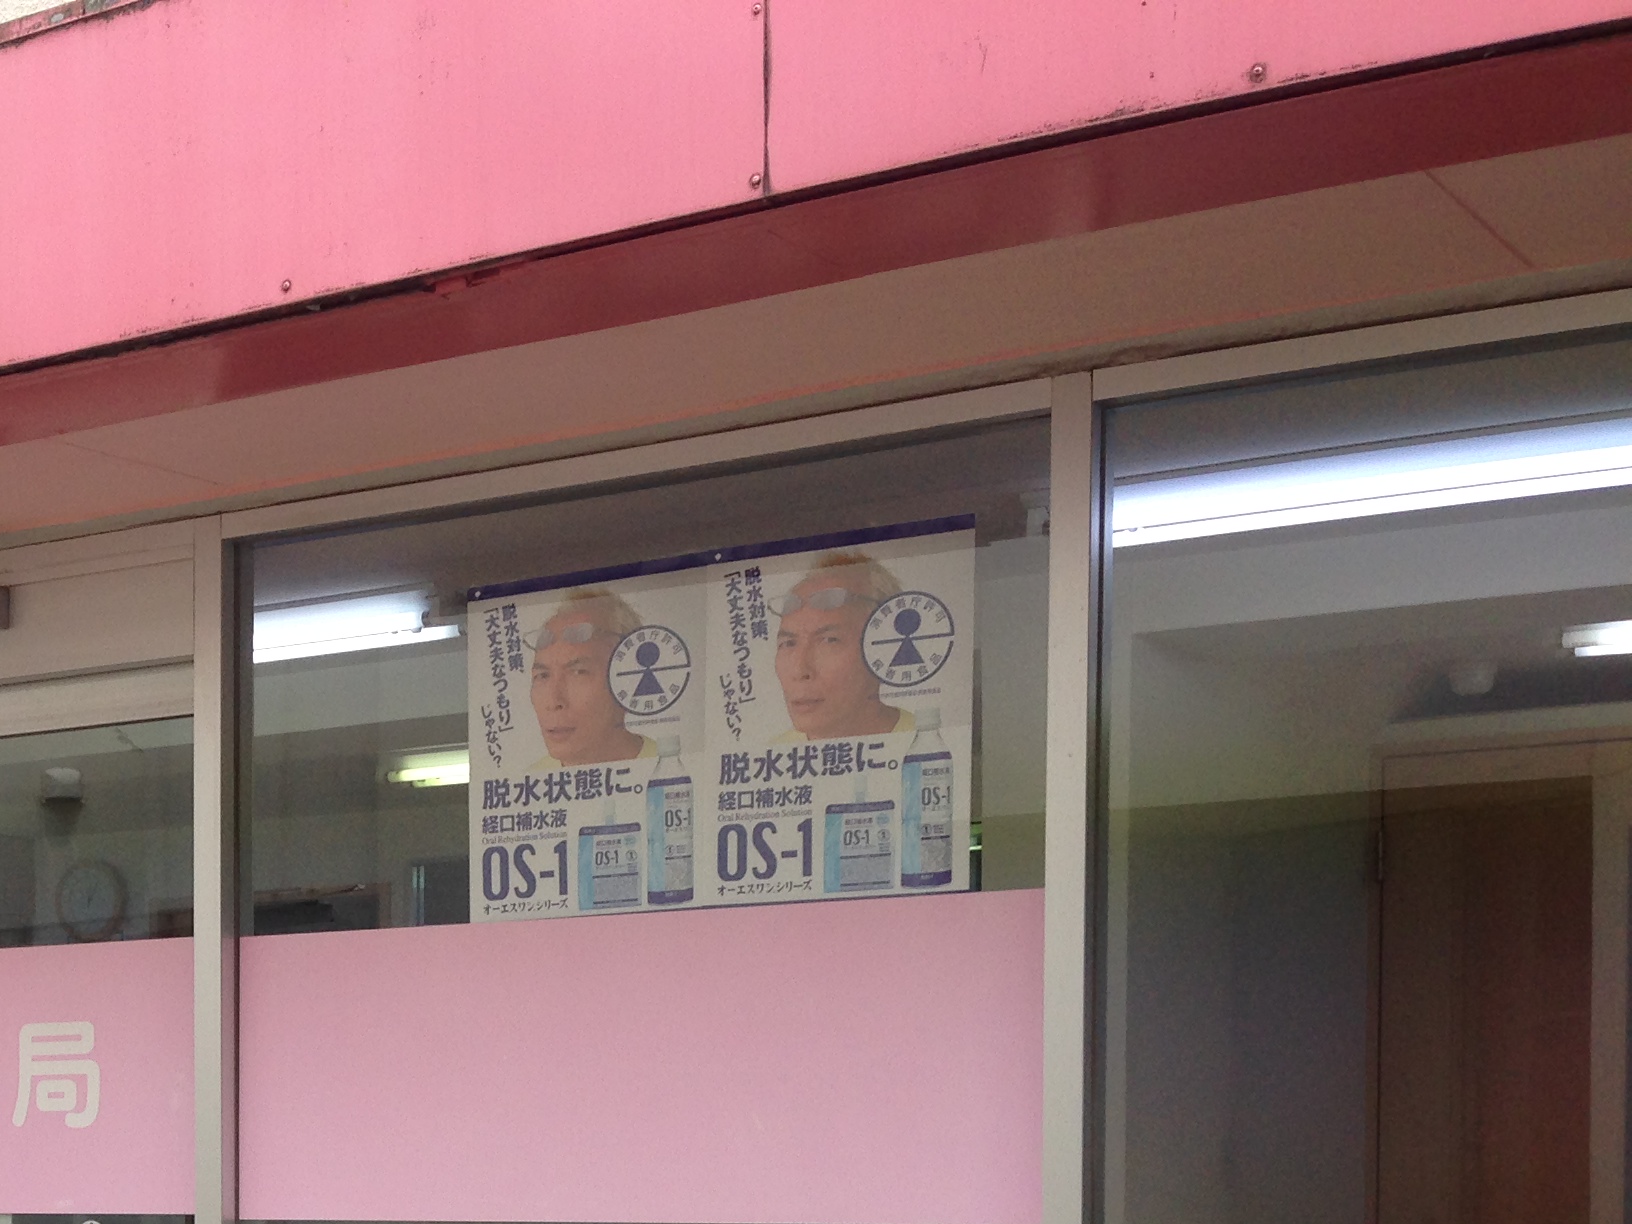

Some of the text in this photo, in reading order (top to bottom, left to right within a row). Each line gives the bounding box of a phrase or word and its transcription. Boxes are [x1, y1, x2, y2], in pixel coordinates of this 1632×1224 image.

[719, 742, 898, 785] 脱水状態に。
[482, 767, 643, 809] 脱水状態に。
[718, 785, 812, 811] 経口補水液
[482, 809, 567, 834] 経口補水液
[718, 812, 734, 822] Oral
[781, 807, 812, 816] Solution
[718, 817, 812, 881] OS-1
[843, 829, 869, 846] OS-1
[482, 840, 568, 901] OS-1
[595, 850, 619, 866] OS-1
